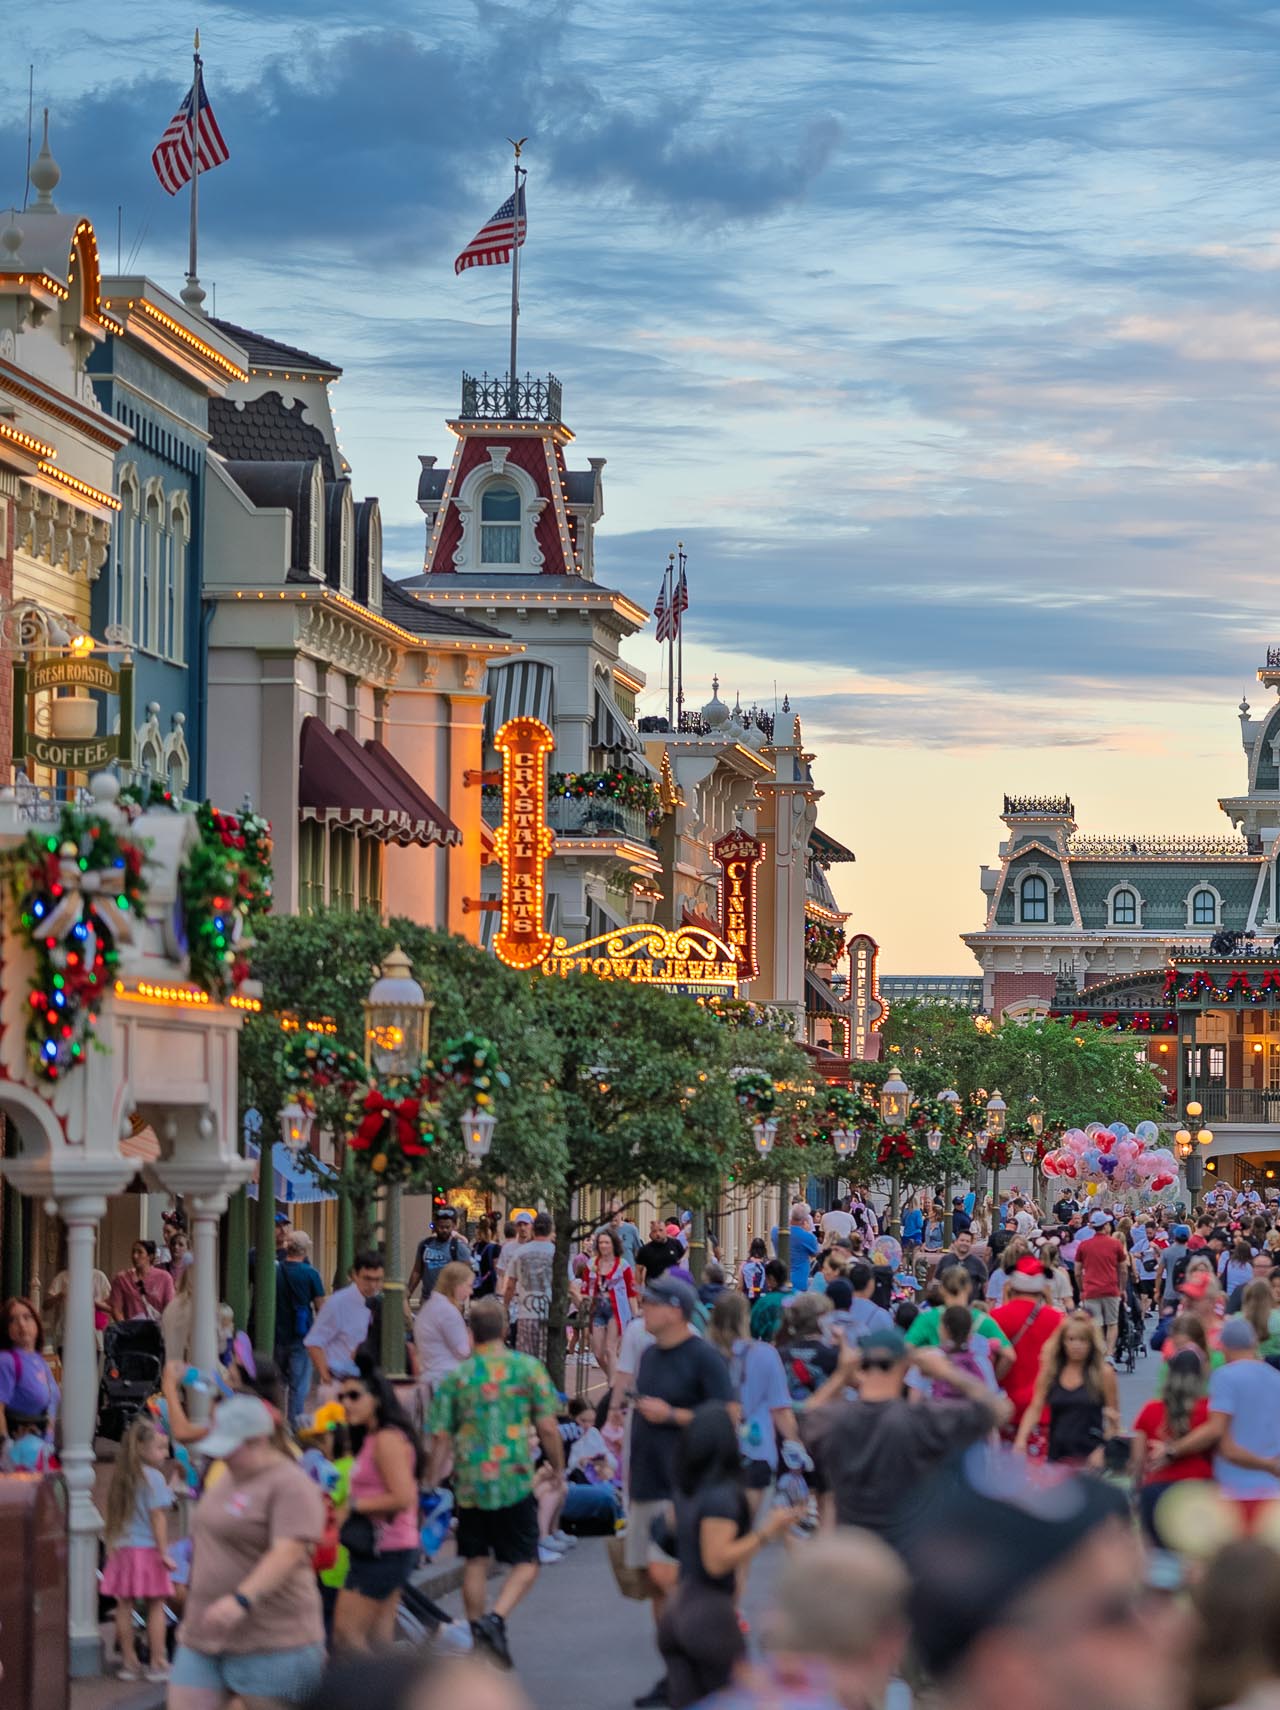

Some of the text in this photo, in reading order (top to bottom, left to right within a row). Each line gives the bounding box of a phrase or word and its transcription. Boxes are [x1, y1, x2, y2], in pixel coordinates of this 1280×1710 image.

[34, 664, 113, 687] FRESH ROASTED
[36, 743, 108, 765] COFFEE
[512, 752, 535, 933] CRYSTAL ARTS
[718, 841, 754, 856] MAIN
[541, 957, 654, 978] UPTOWN
